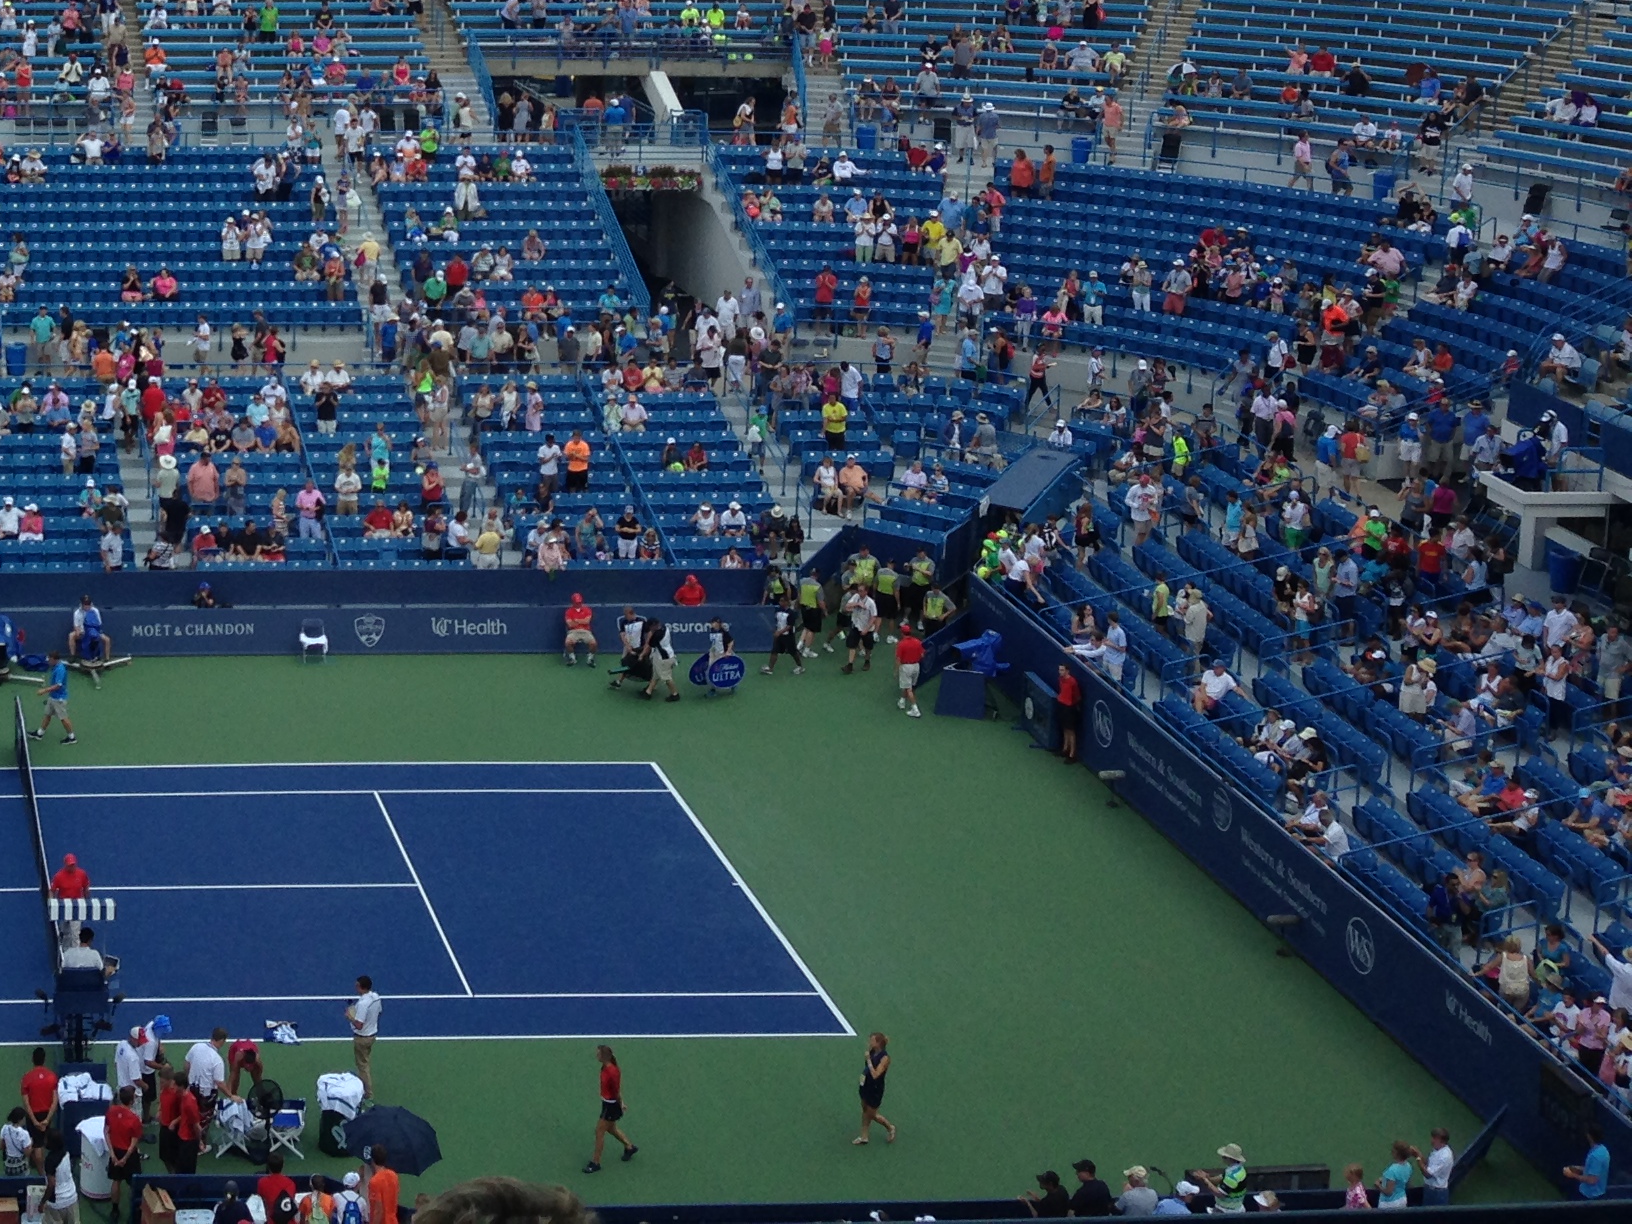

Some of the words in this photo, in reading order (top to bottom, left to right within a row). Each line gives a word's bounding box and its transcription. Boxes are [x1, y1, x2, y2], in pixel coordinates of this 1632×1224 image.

[637, 165, 644, 176] 5
[132, 623, 171, 637] MOËT
[173, 626, 182, 636] &
[184, 623, 254, 636] CHANDON
[454, 618, 507, 635] Health
[712, 670, 741, 682] ULTRA
[1458, 1003, 1493, 1047] Health
[280, 1197, 292, 1212] G
